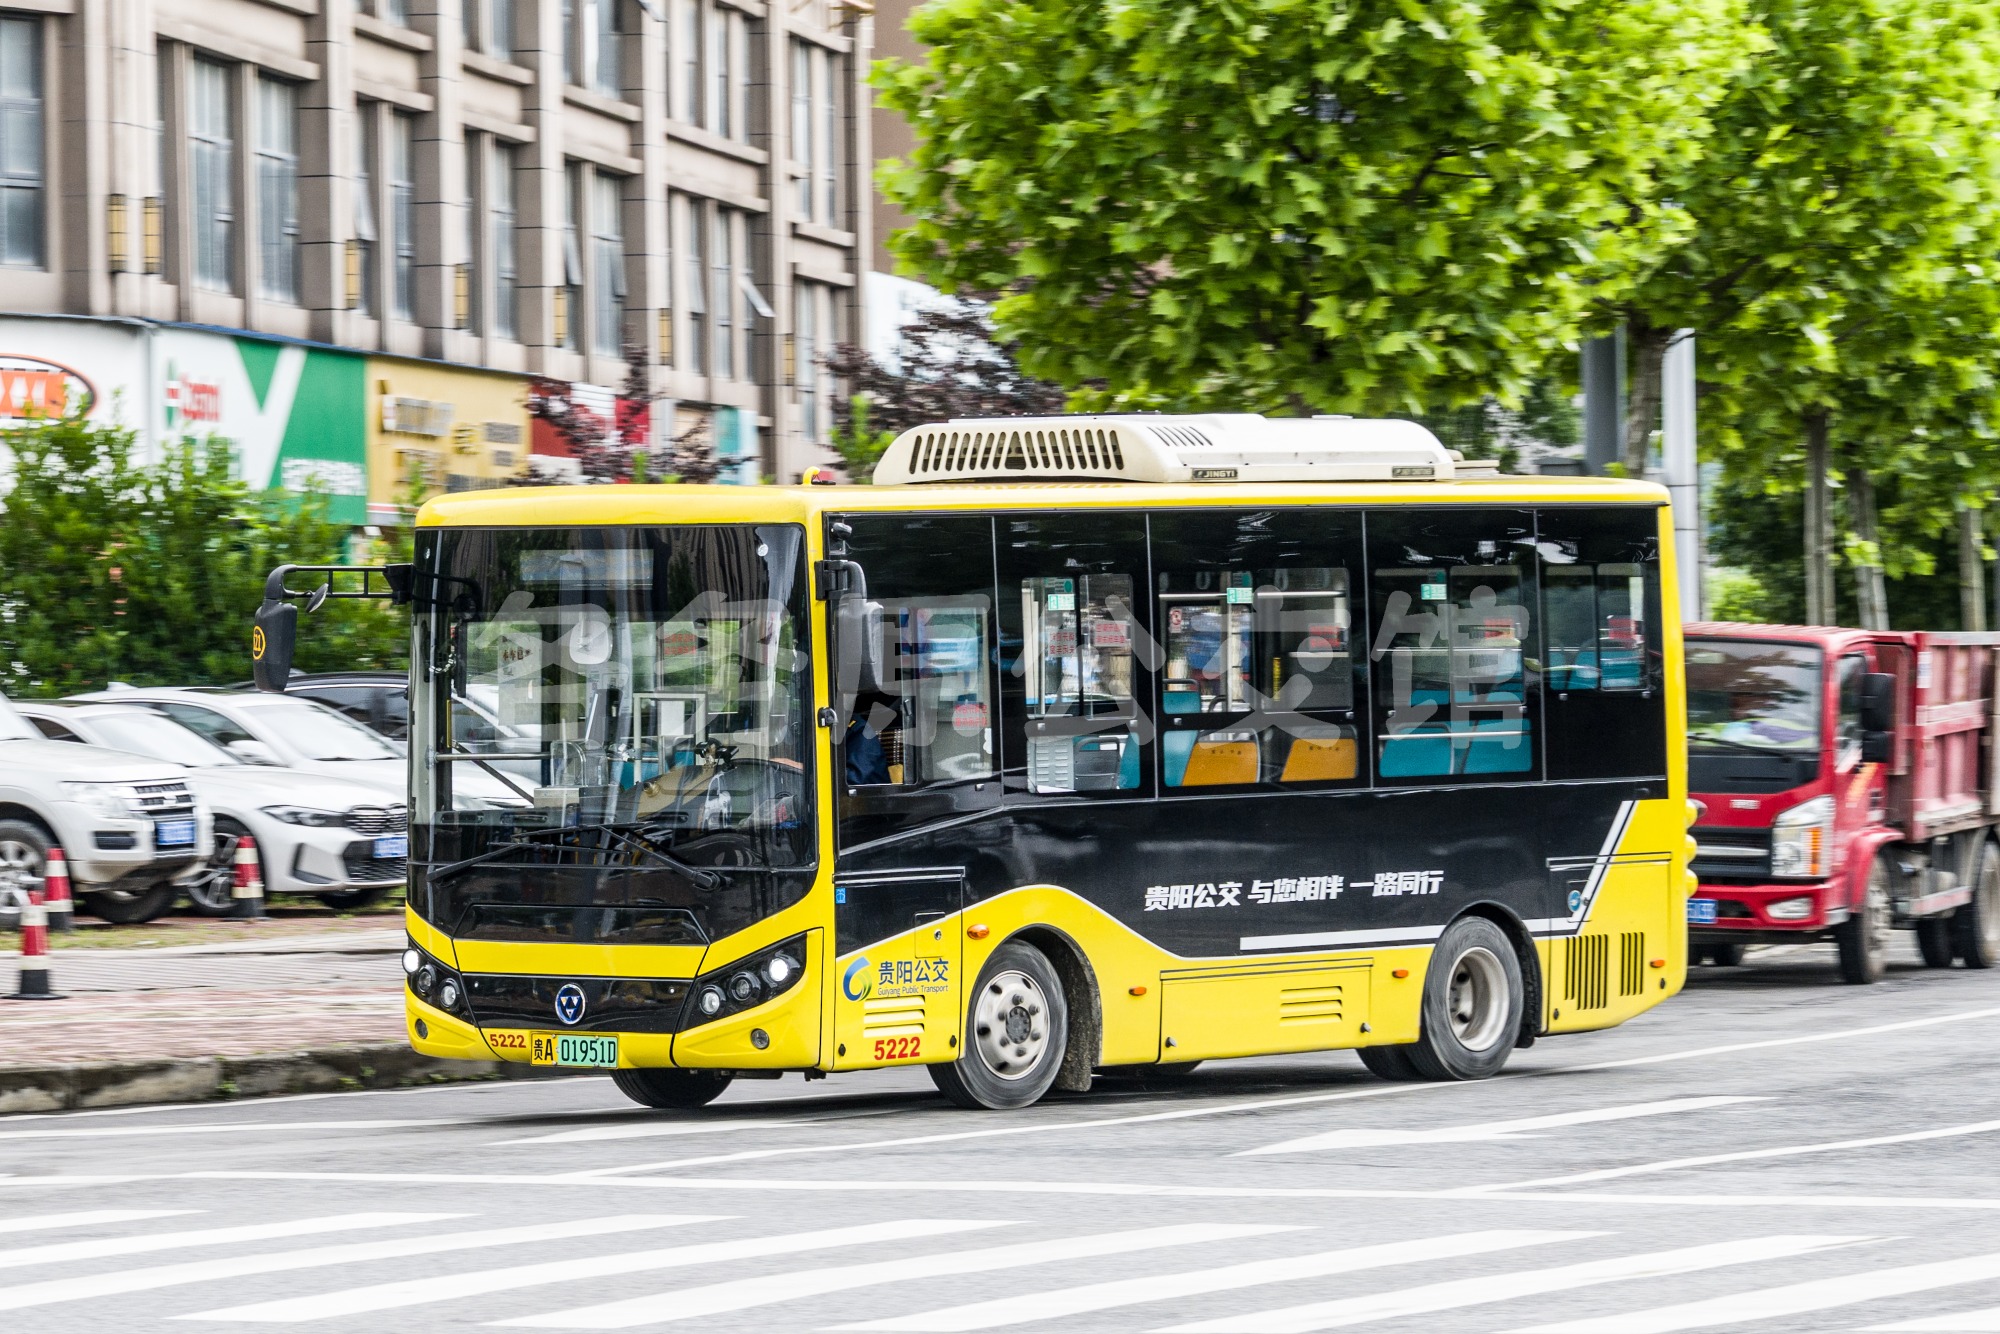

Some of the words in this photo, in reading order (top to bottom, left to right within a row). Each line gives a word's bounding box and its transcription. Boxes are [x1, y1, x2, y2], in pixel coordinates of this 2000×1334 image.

[1143, 881, 1243, 912] 贵阳公交
[1247, 874, 1344, 904] 与您相伴
[1349, 869, 1445, 897] 一路同行
[878, 958, 949, 986] 贵阳公交
[877, 987, 901, 997] Guiyang
[901, 985, 919, 994] Public
[921, 984, 949, 994] Transport
[489, 1033, 527, 1048] 5222
[873, 1036, 921, 1061] 5222
